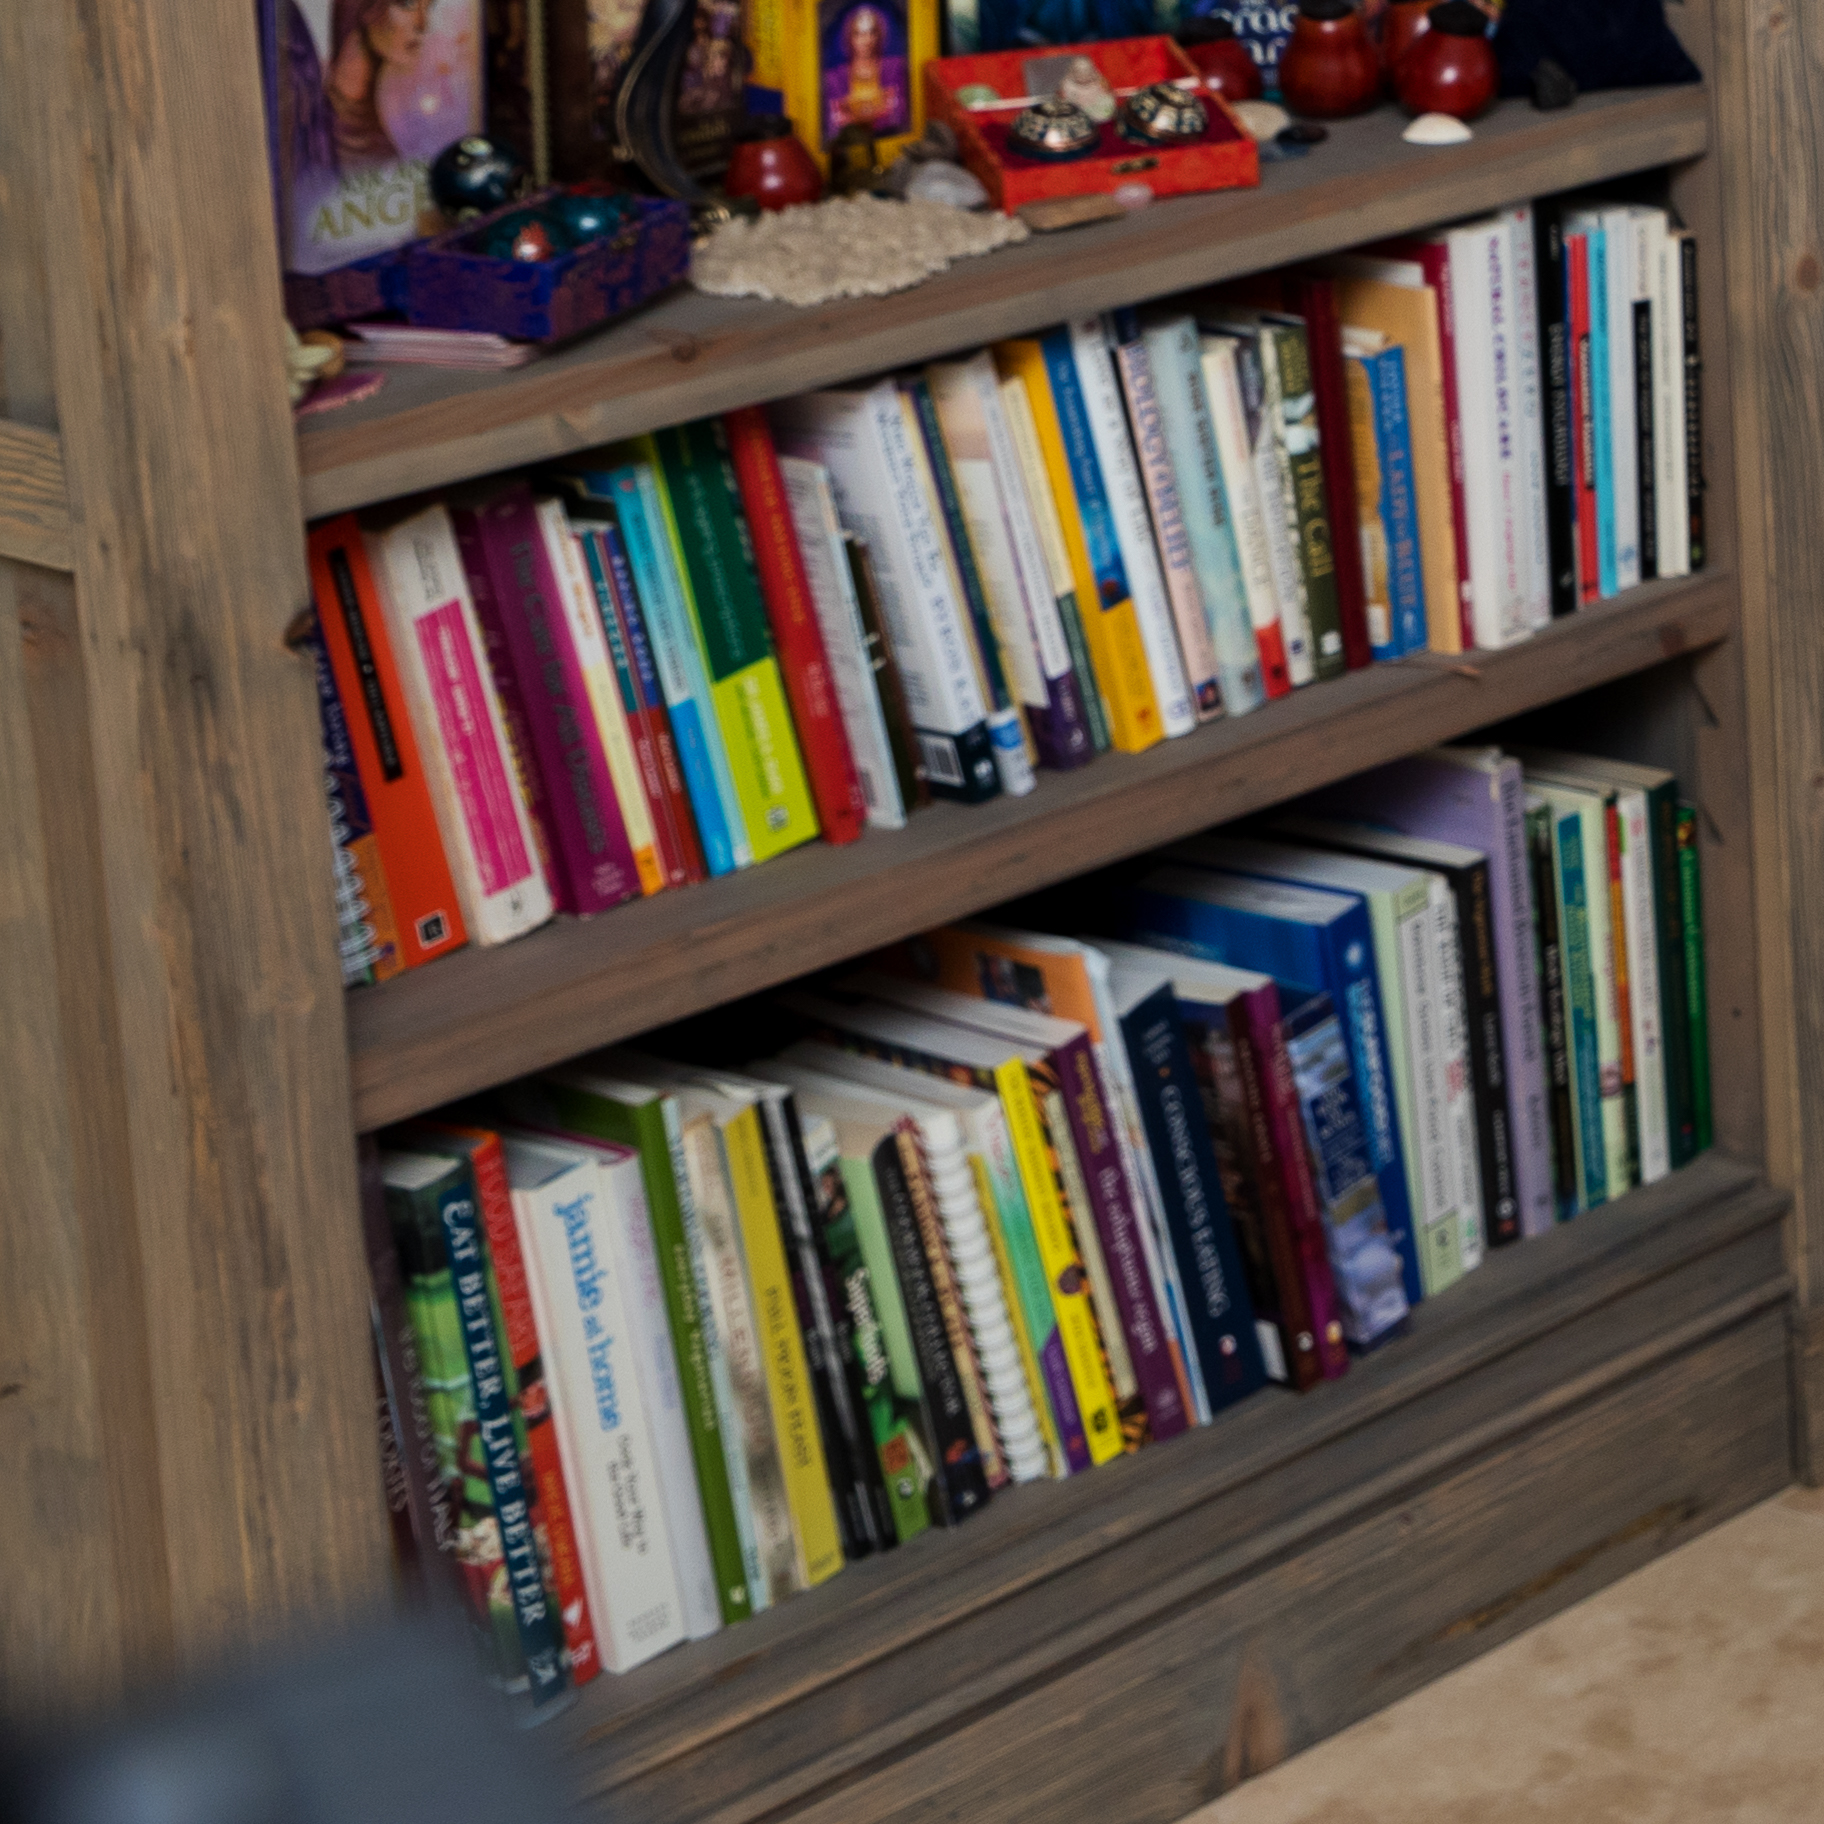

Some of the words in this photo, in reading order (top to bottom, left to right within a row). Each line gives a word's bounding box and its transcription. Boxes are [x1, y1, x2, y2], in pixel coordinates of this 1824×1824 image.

[1294, 458, 1325, 513] The
[507, 540, 543, 594] The
[1300, 515, 1334, 578] Call
[519, 591, 560, 658] Cure
[538, 657, 571, 697] for
[549, 702, 584, 747] All
[559, 746, 611, 856] Diseases
[441, 1198, 487, 1267] EAT
[1152, 1082, 1214, 1232] CONSCIOUS
[1186, 1228, 1235, 1319] EATING
[549, 1194, 612, 1313] jamie
[454, 1268, 513, 1411] BETTER,
[578, 1313, 601, 1339] at
[840, 1267, 894, 1385] Superfoods
[582, 1338, 627, 1432] home
[481, 1412, 529, 1497] LIVE
[497, 1499, 554, 1628] BETTER
